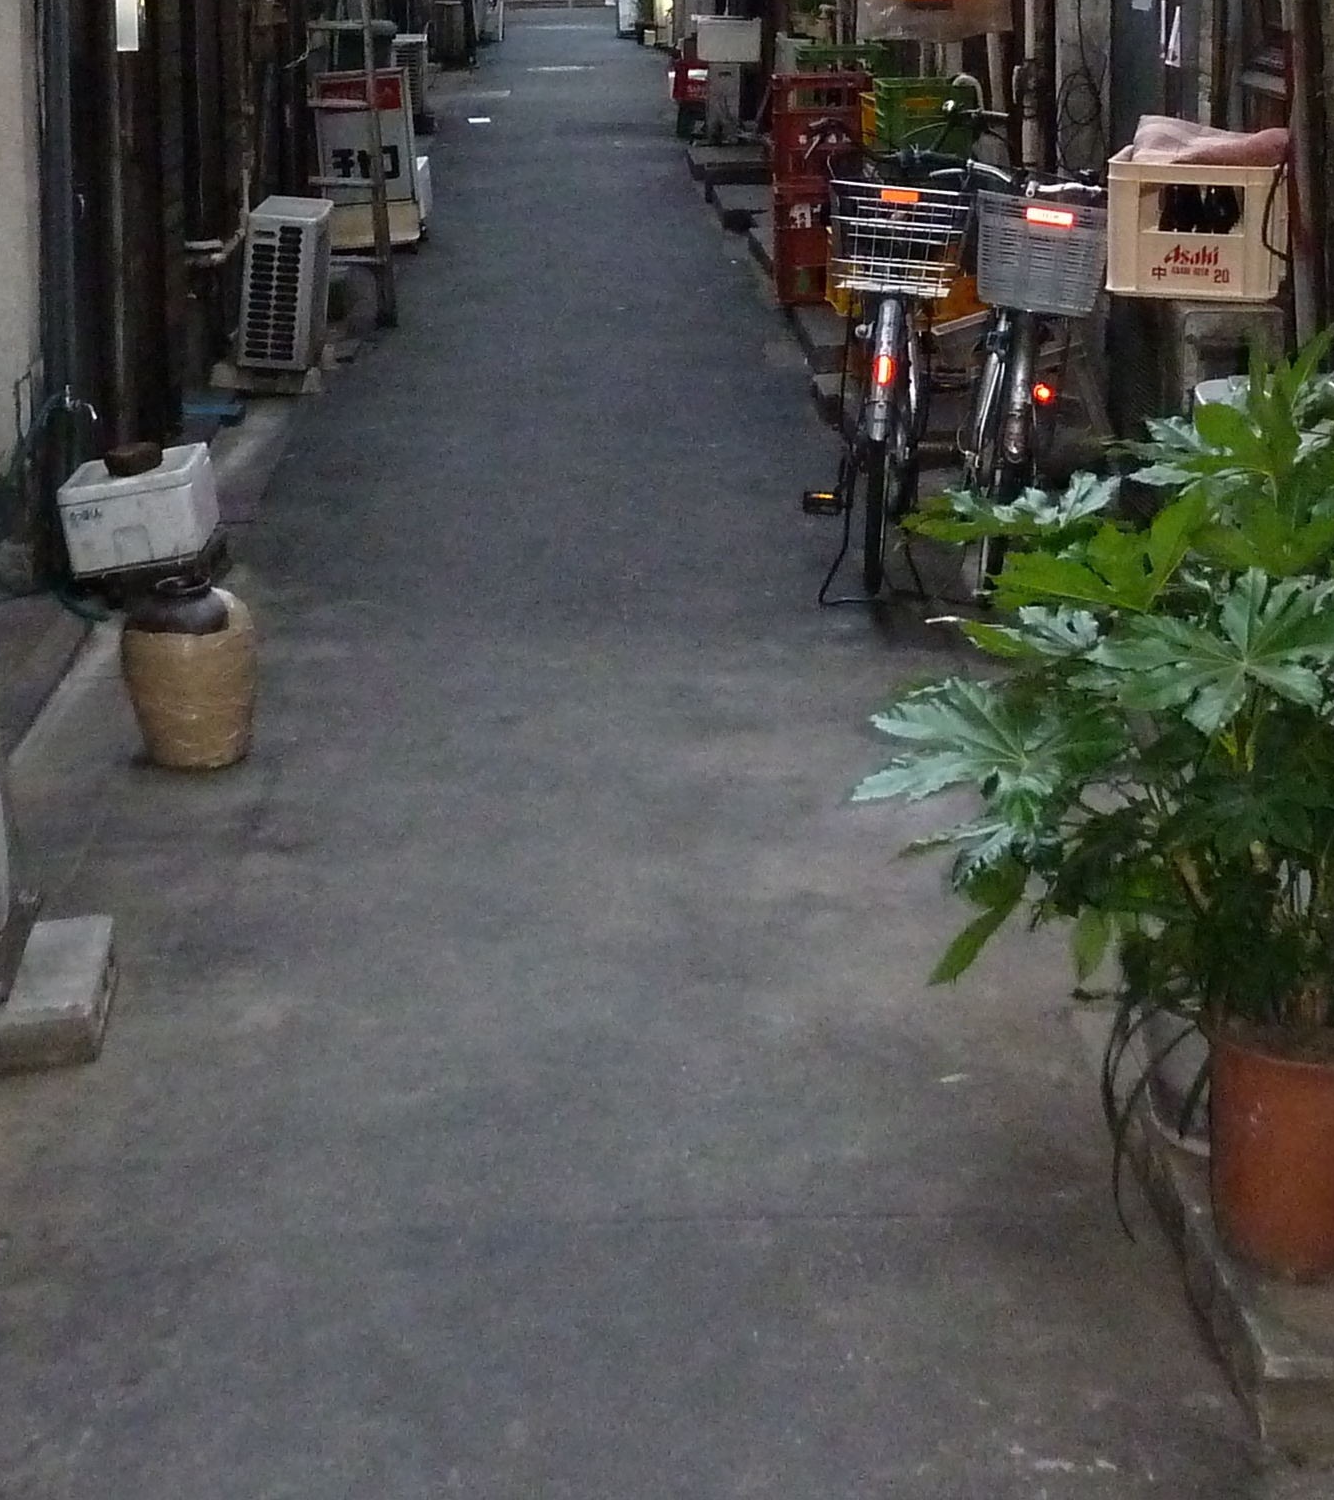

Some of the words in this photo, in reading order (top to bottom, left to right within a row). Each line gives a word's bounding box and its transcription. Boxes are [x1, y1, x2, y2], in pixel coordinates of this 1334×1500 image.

[1164, 244, 1220, 266] Asahi
[1151, 265, 1167, 282] 中
[1214, 269, 1230, 284] 20
